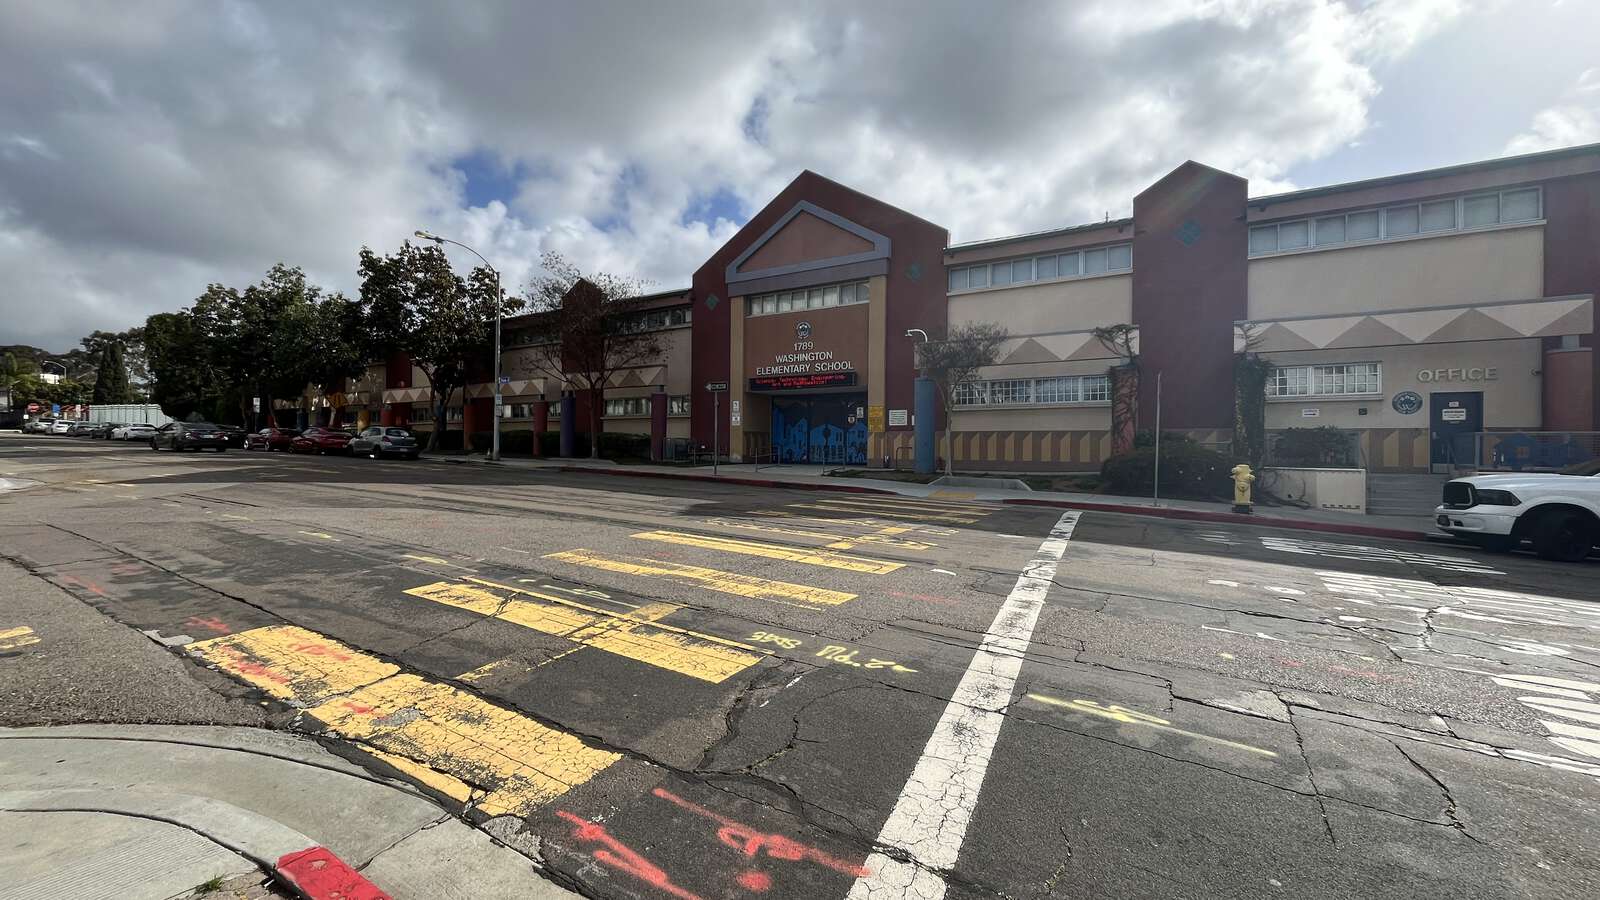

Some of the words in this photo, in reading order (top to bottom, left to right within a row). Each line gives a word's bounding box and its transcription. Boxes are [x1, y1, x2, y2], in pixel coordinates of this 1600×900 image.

[794, 341, 814, 351] 1789
[775, 351, 833, 363] WASHINGTON
[756, 363, 811, 376] ELEMENTARY
[815, 361, 854, 372] SCHOOL
[1418, 367, 1498, 382] OFFICE
